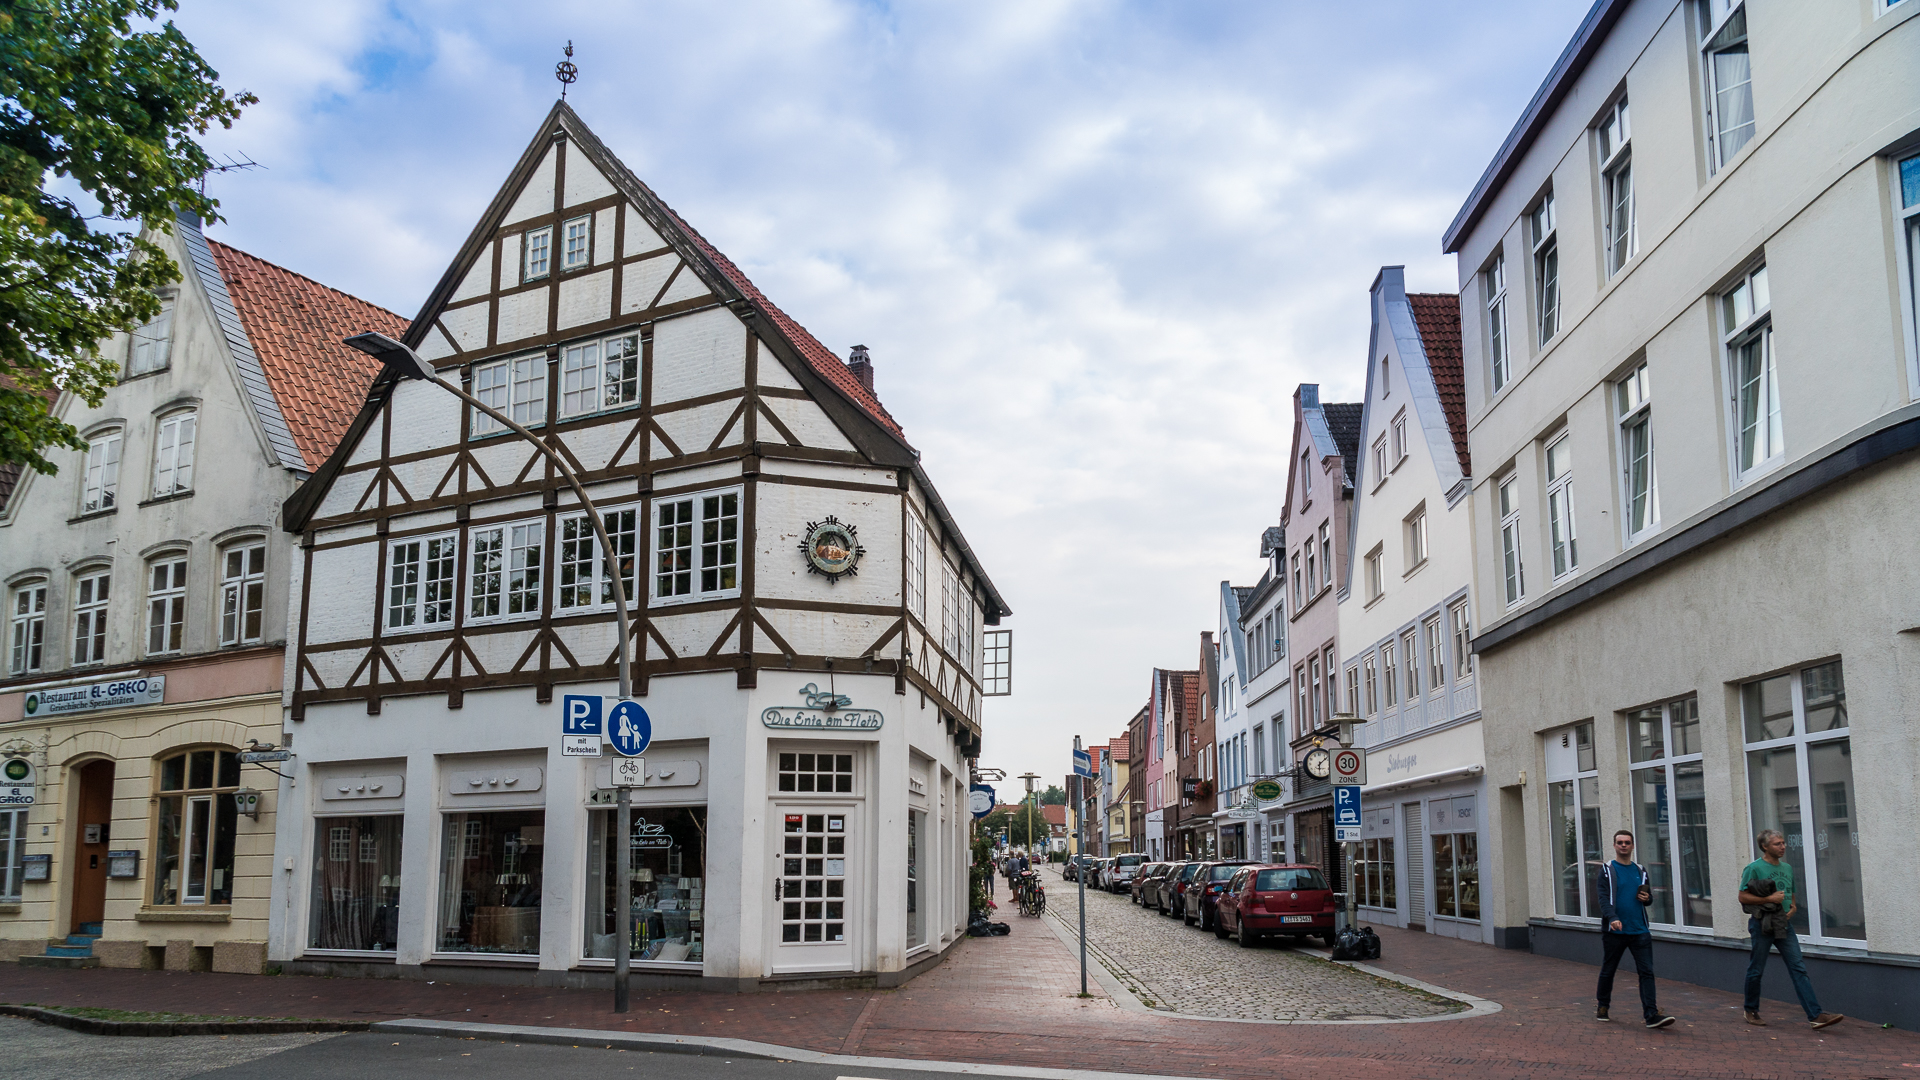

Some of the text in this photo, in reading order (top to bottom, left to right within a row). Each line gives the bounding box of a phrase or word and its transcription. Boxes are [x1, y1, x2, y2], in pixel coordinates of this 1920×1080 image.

[39, 679, 148, 704] Restaurant EL-GRECO
[49, 696, 135, 712] Griechische Spezialitäten
[569, 699, 591, 730] P
[766, 709, 791, 726] Die
[793, 711, 822, 726] Ente
[825, 716, 843, 727] am
[566, 746, 597, 754] Parkschein
[1340, 757, 1355, 769] 30
[0, 795, 35, 804] GRECO
[11, 787, 22, 796] EL
[1338, 788, 1350, 804] P
